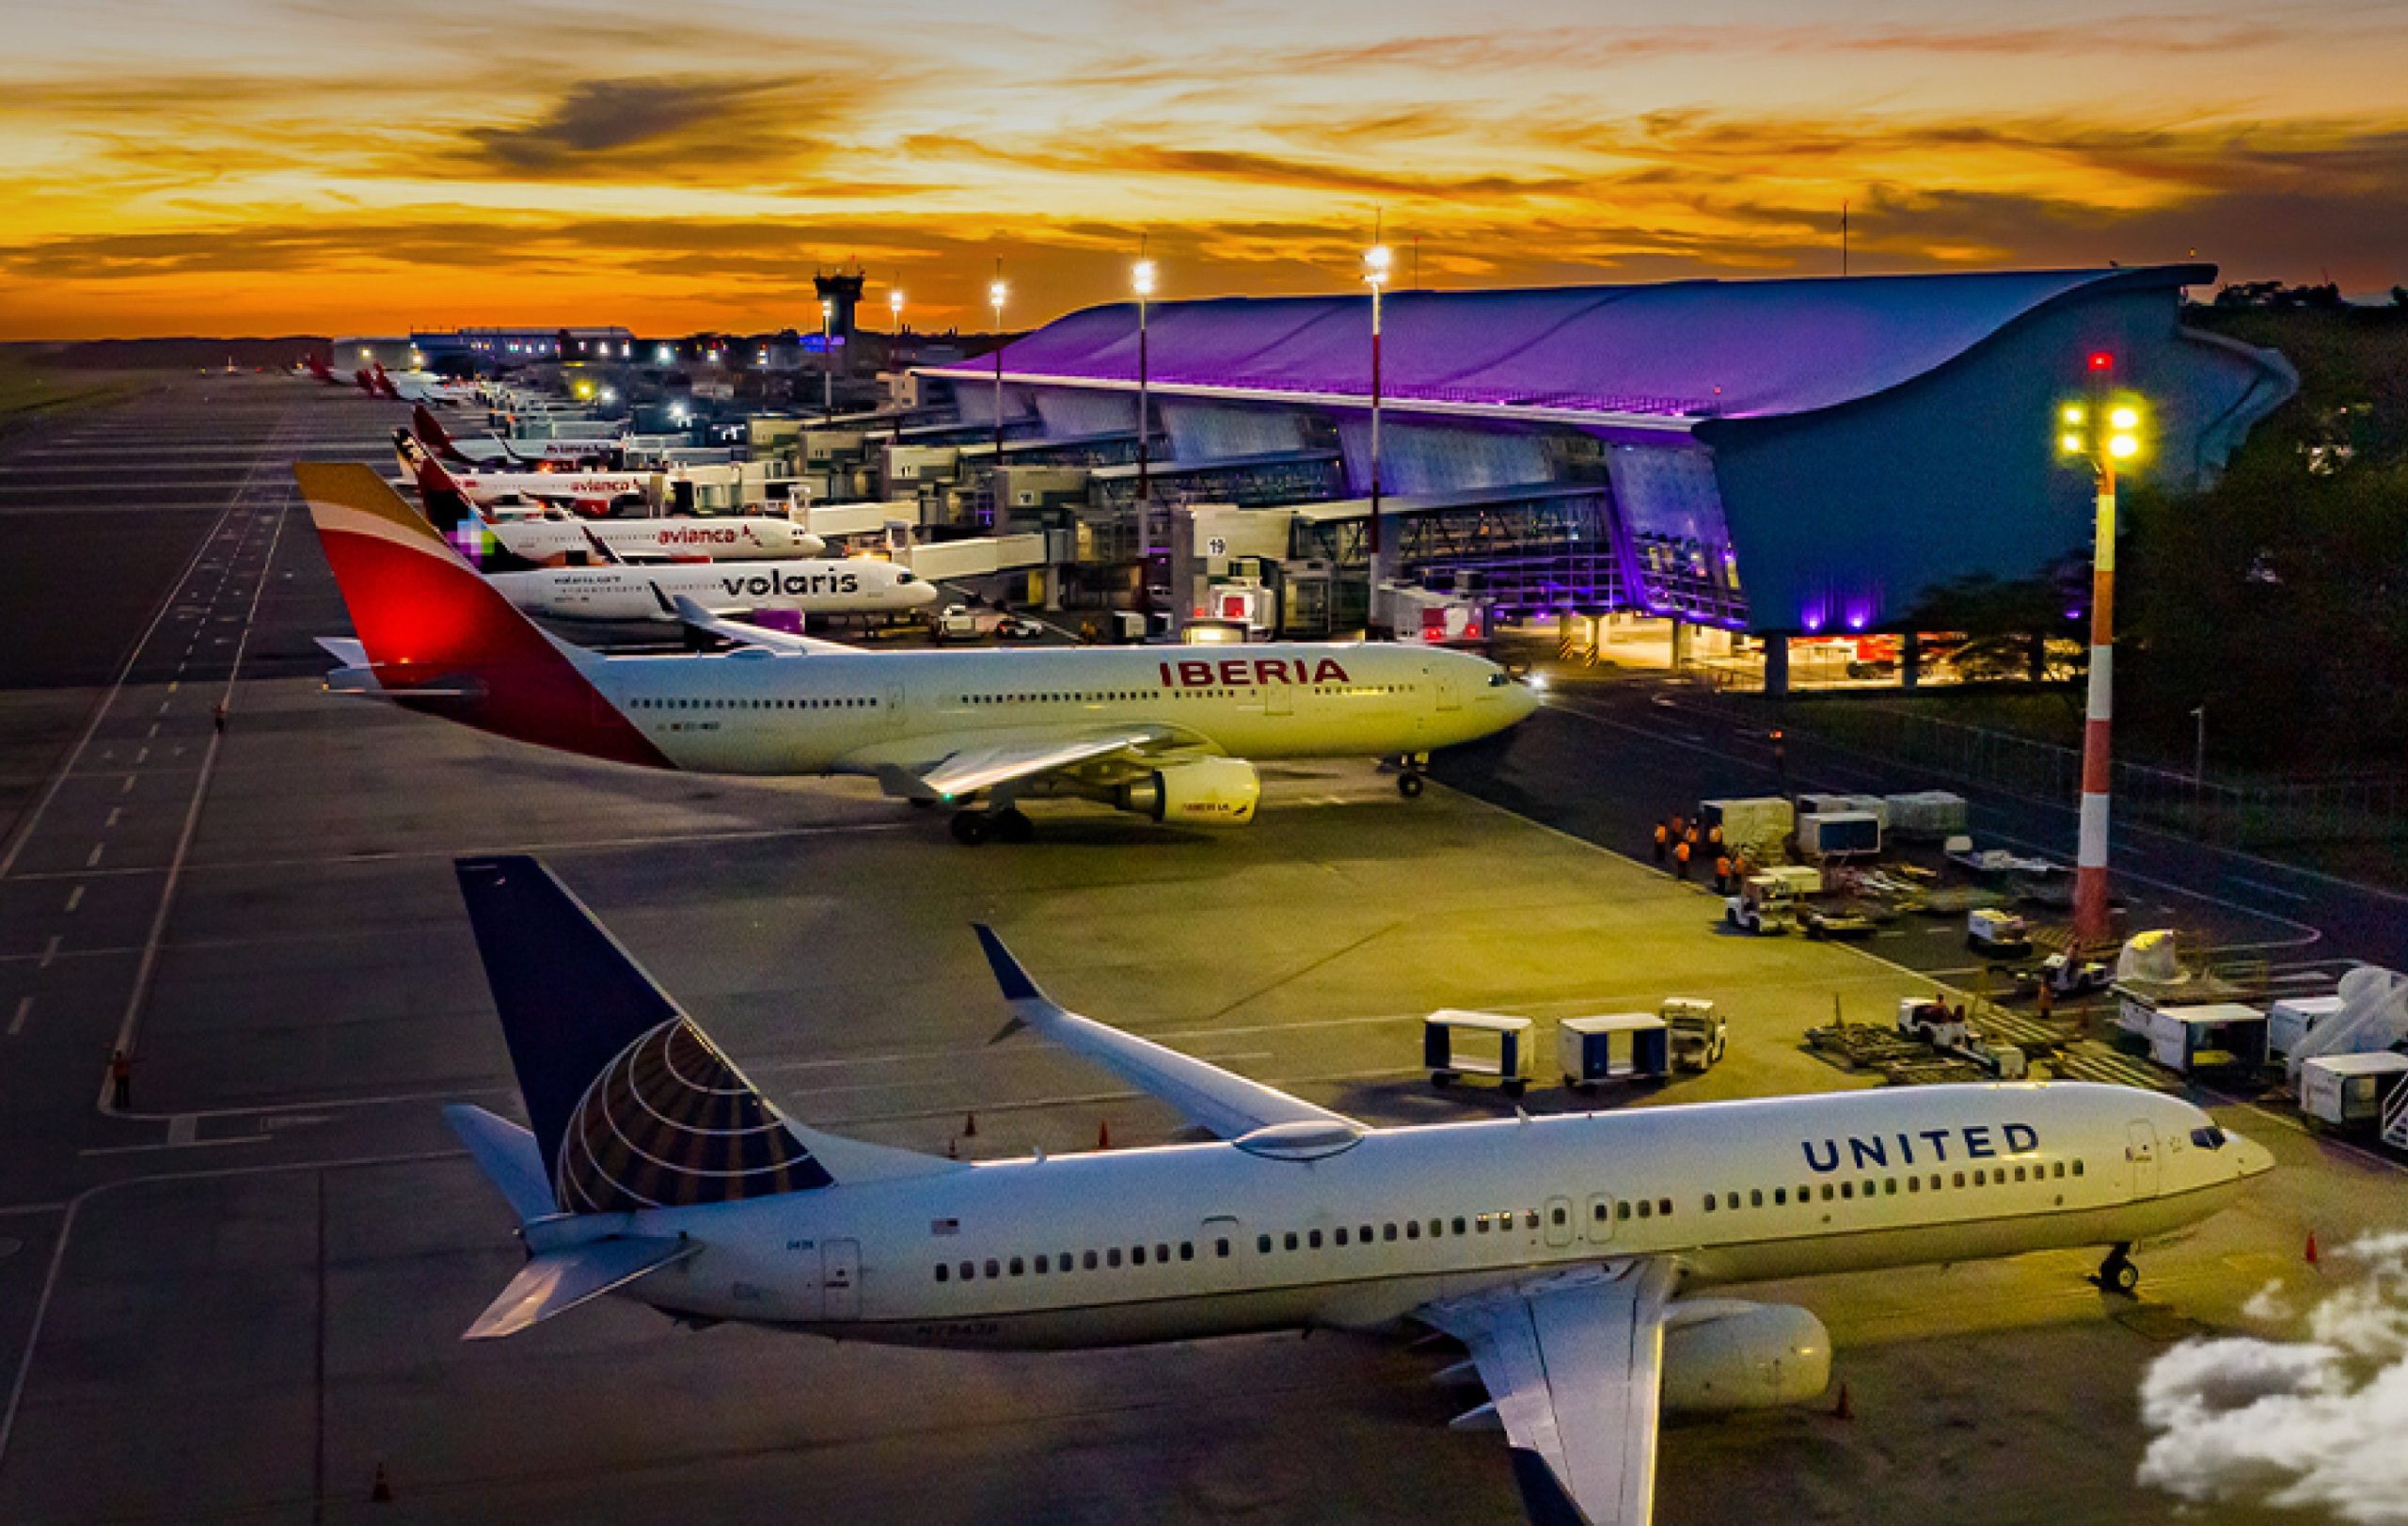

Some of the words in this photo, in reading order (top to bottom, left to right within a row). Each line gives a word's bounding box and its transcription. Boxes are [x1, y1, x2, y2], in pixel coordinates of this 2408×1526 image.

[657, 525, 737, 545] avianca
[721, 565, 859, 596] volaris
[1159, 657, 1351, 688] IBERIA
[1800, 1122, 2040, 1173] UNITED
